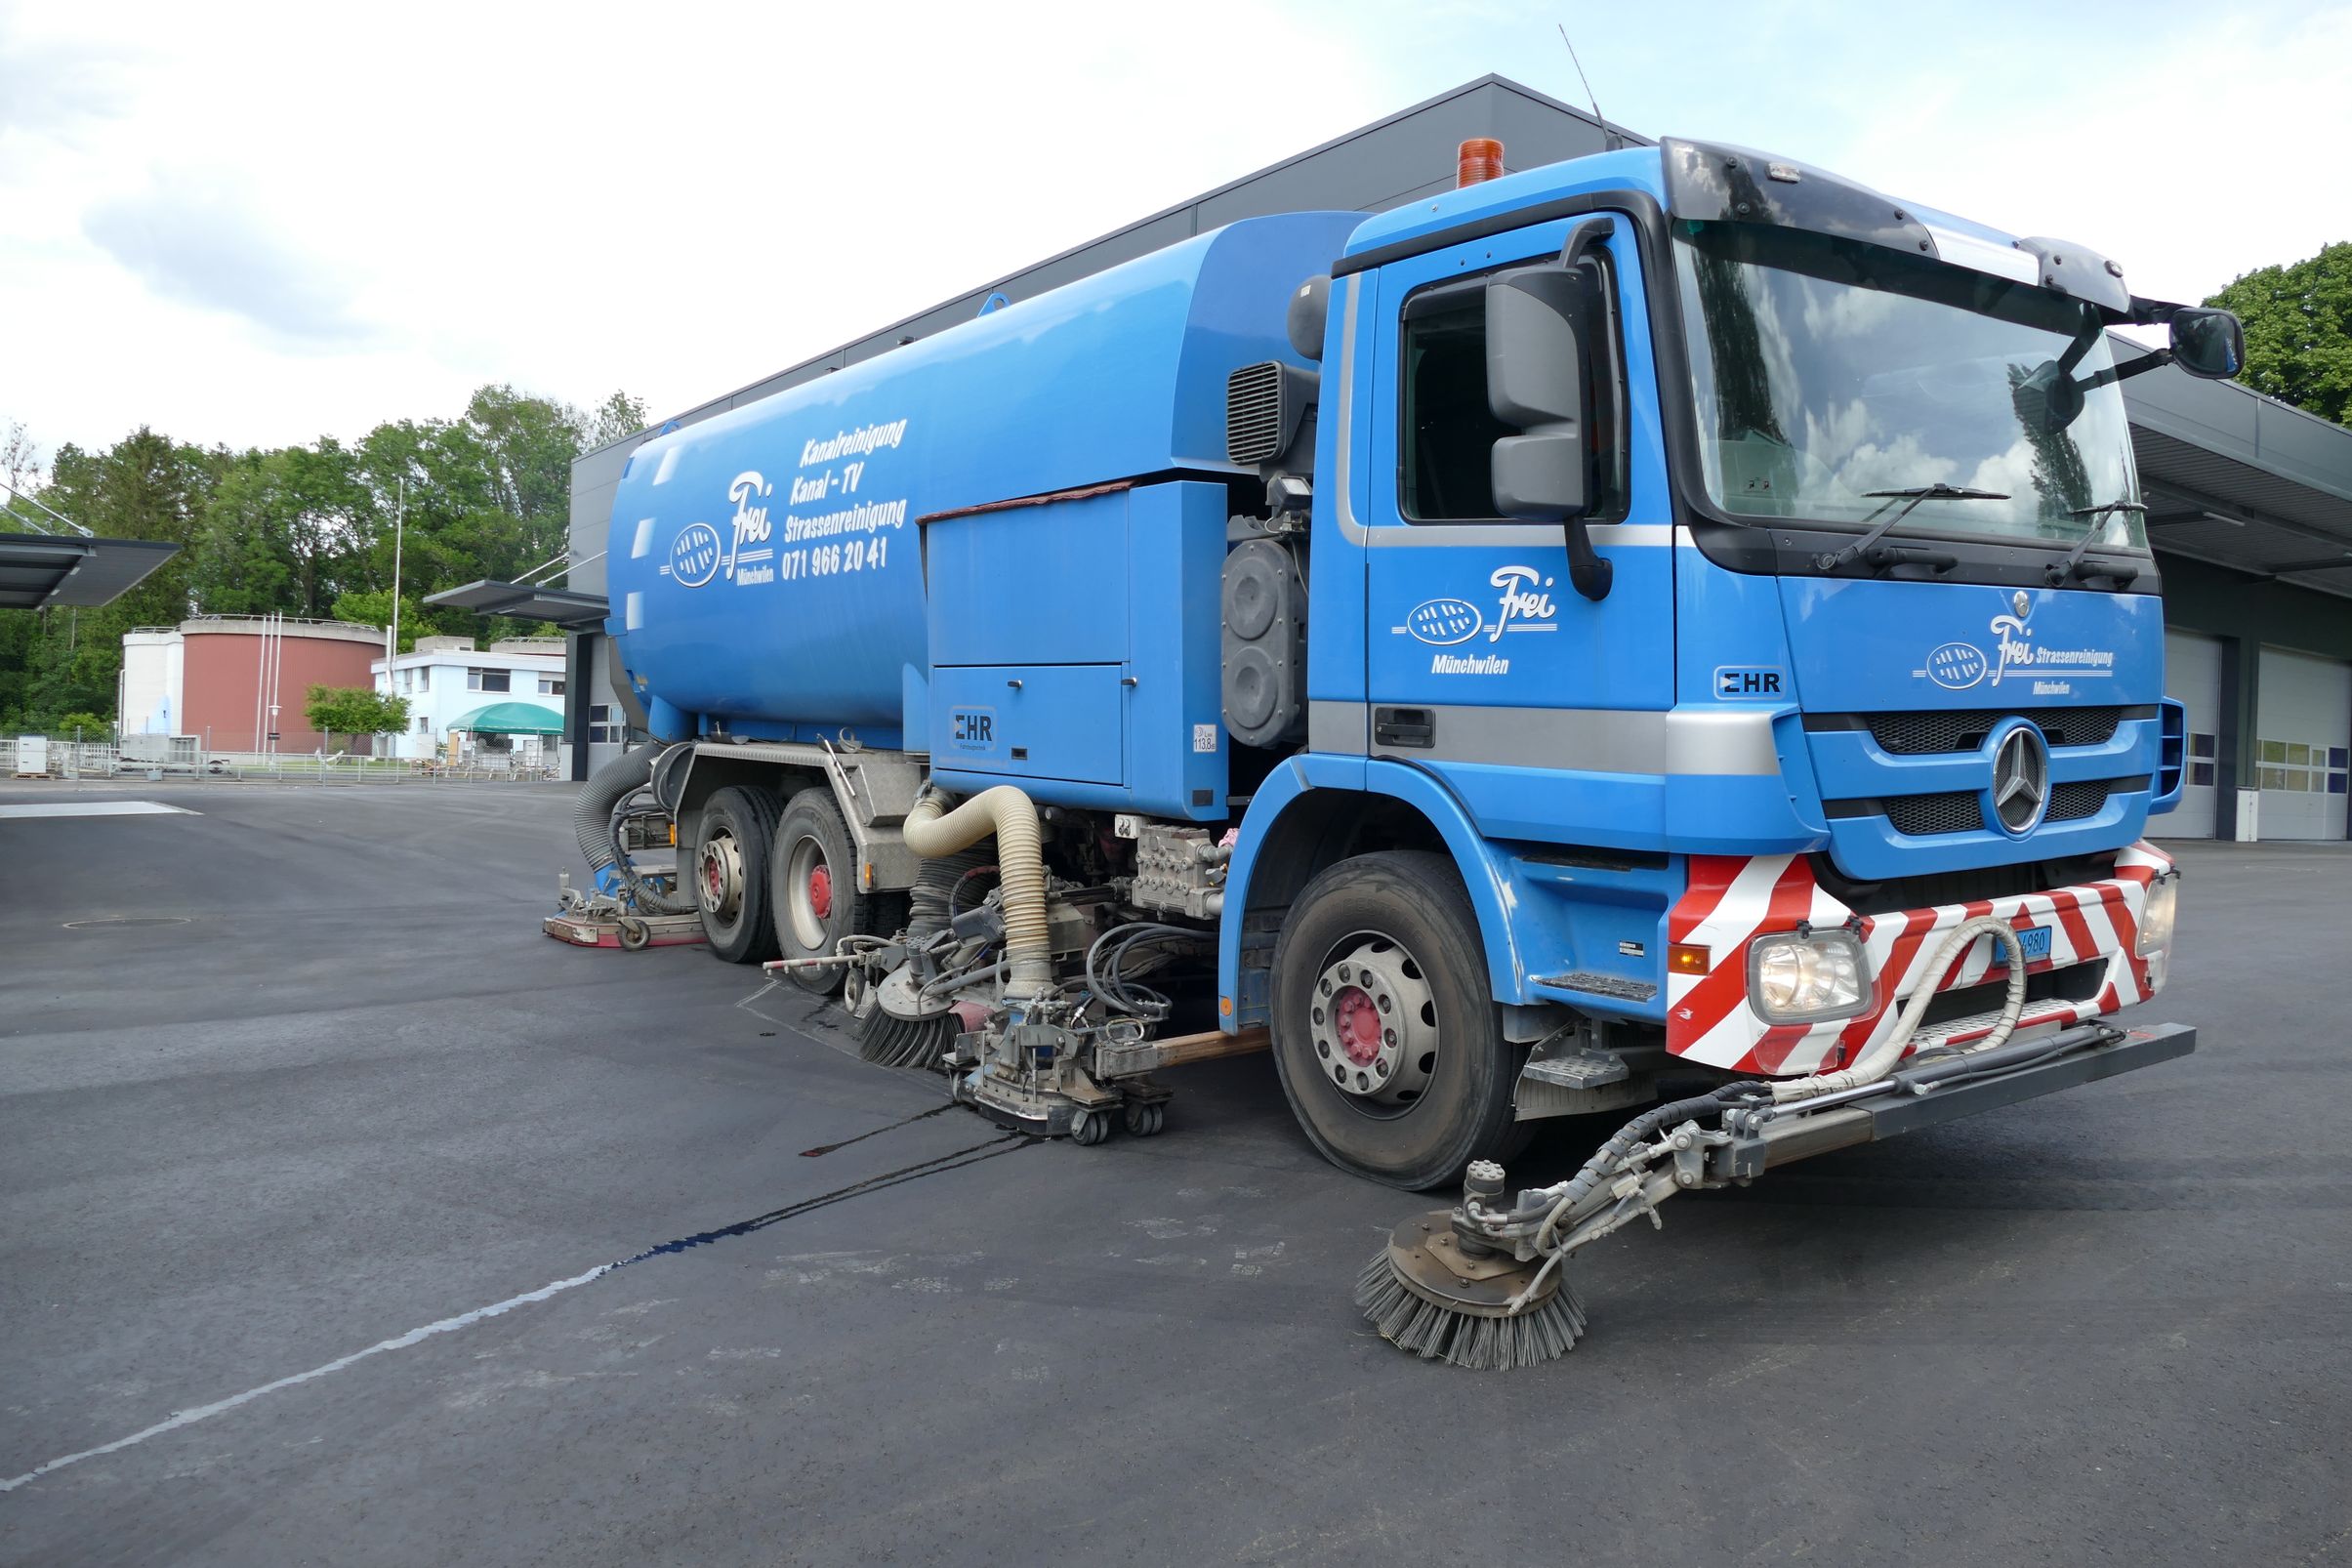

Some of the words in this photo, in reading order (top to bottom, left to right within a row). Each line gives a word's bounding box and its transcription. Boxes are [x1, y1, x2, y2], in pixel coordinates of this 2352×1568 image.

[799, 418, 907, 469] Kanalreinigung
[789, 469, 831, 506] Kanal
[842, 461, 864, 494] TV
[784, 499, 907, 544] Strassenreinigung
[736, 565, 774, 586] Münchwilen
[782, 549, 807, 581] 071
[811, 543, 841, 577] 966
[844, 540, 864, 573] 20
[867, 536, 887, 570] 41
[1490, 565, 1555, 642] Frei
[1431, 653, 1509, 675] Münchwilen
[1991, 615, 2034, 686] Frei
[2036, 646, 2114, 667] Strassenreinigung
